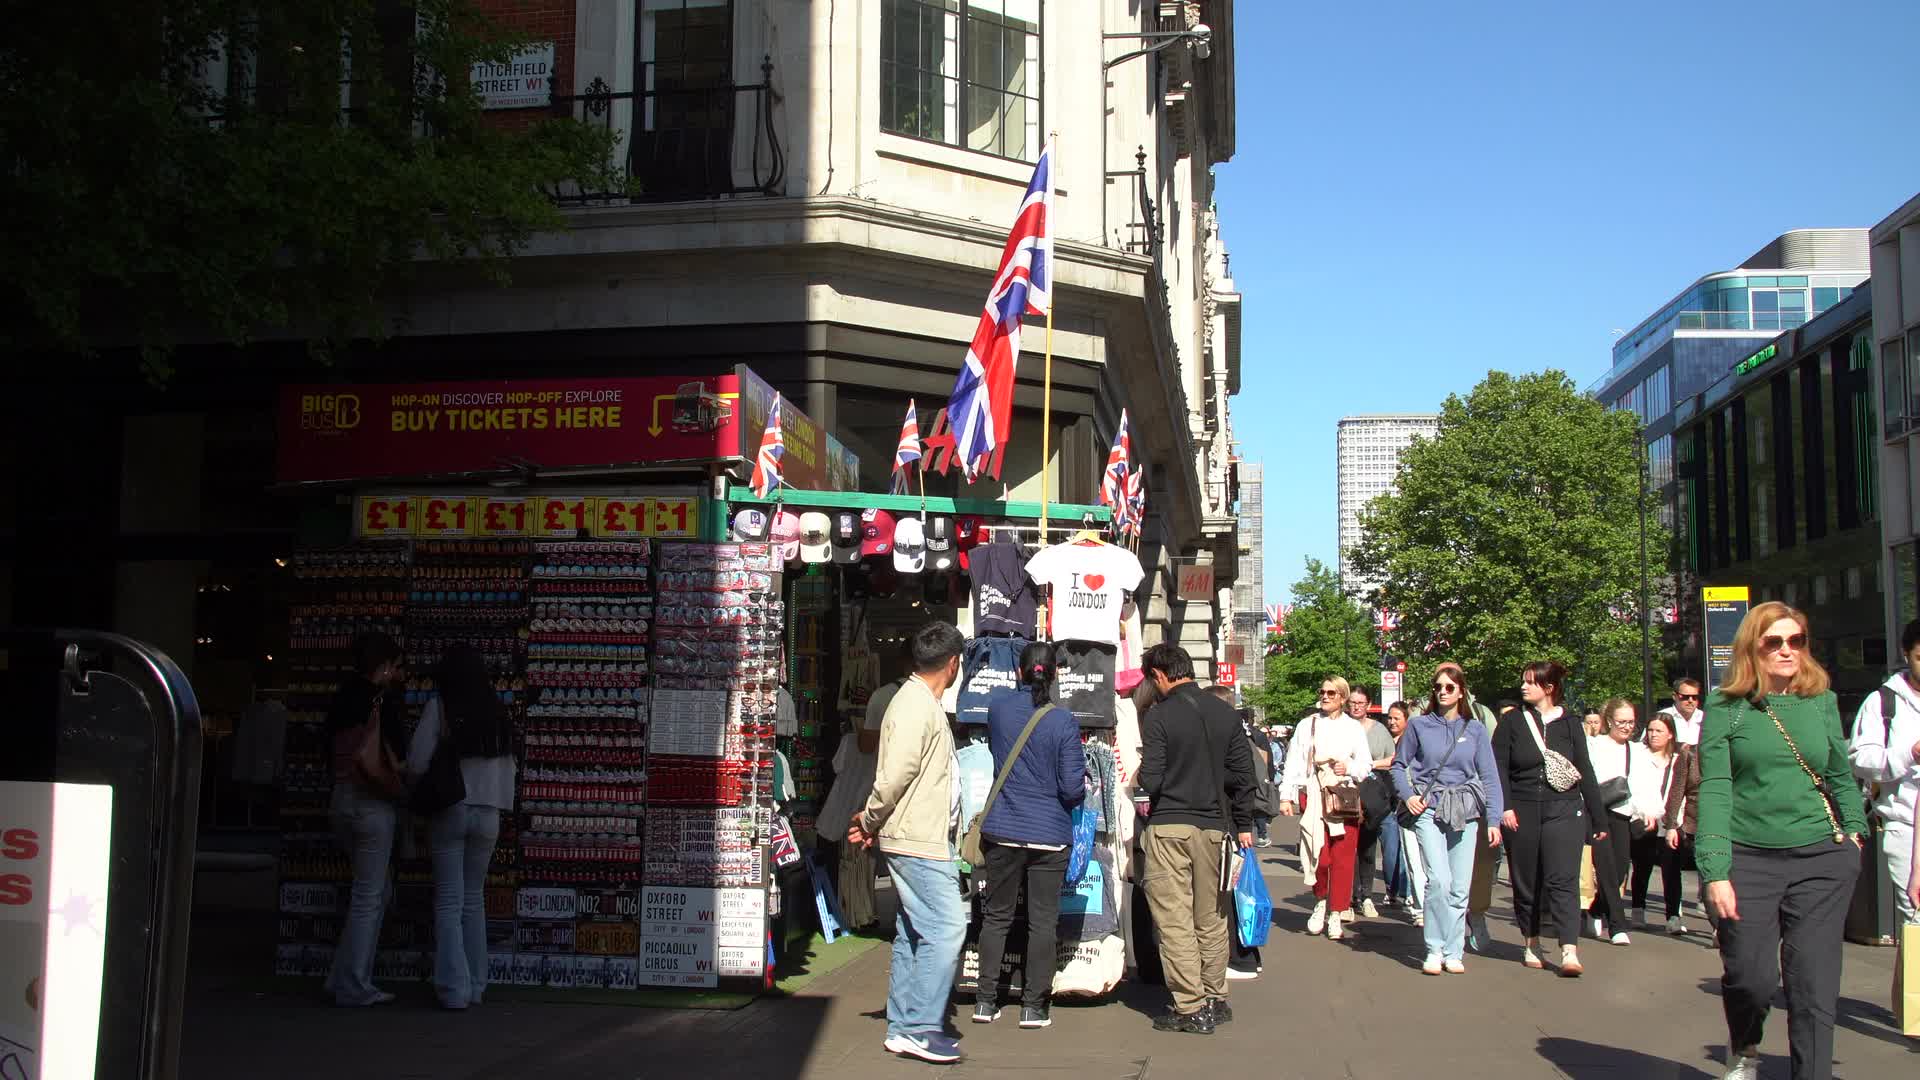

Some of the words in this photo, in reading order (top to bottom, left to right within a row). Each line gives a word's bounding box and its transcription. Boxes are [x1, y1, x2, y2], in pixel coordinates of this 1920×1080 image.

[477, 62, 546, 77] TITCHFIELD
[479, 79, 520, 92] STREET
[526, 78, 543, 90] W1
[302, 394, 335, 412] BIG
[391, 394, 441, 407] HOP-ON
[442, 392, 504, 406] DISCOVER
[506, 391, 563, 405] HOP-OFF
[565, 390, 622, 402] EXPLORE
[391, 409, 440, 432] BUY
[446, 407, 548, 430] TICKETS
[554, 406, 622, 428] HERE
[367, 501, 407, 529] £1
[425, 500, 466, 529] £1
[484, 502, 525, 530] £1
[543, 501, 585, 530] £1
[603, 502, 645, 531] £1
[1071, 572, 1081, 590] I
[1087, 673, 1104, 683] Hill
[681, 831, 715, 841] LONDON
[539, 894, 575, 911] LONDON
[647, 892, 687, 906] OXFORD
[722, 892, 745, 900] OXFORD
[646, 907, 684, 921] STREET
[645, 942, 698, 955] PICCADILLY
[645, 958, 679, 970] CIRCUS
